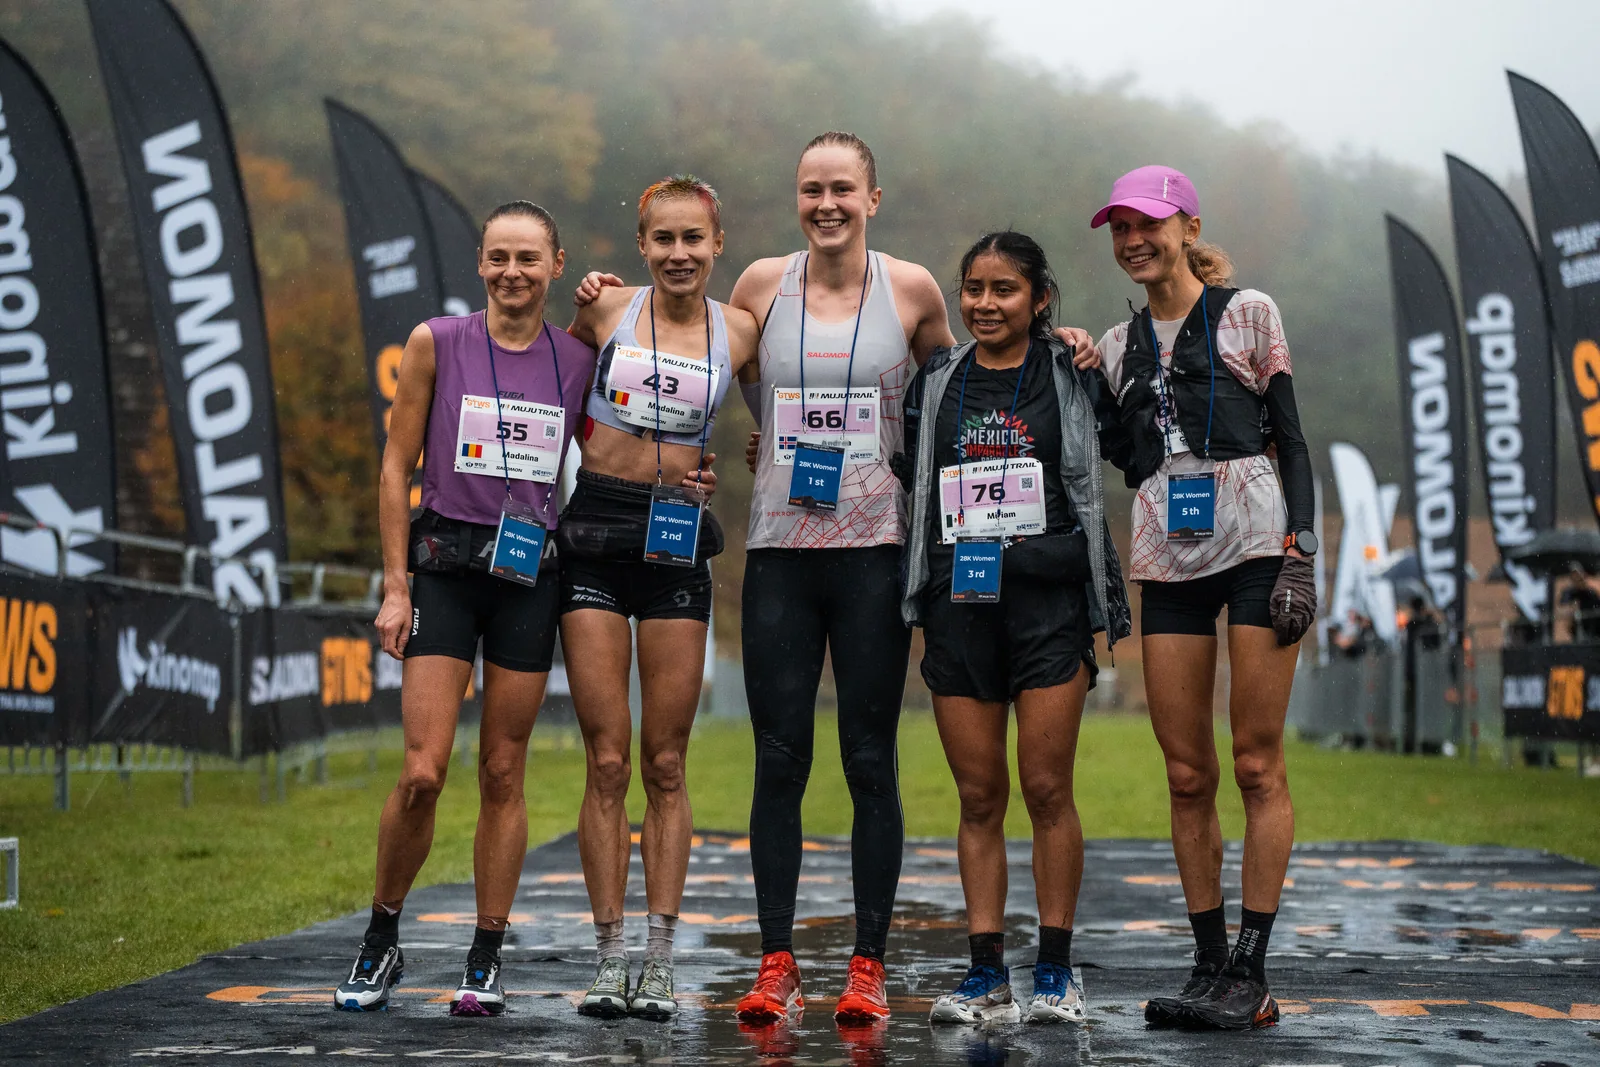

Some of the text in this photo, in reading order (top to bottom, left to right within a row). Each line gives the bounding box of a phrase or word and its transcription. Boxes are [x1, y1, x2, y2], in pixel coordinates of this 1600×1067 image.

[619, 349, 642, 359] GTWS
[661, 357, 689, 369] MUJU
[806, 351, 851, 359] SALOMON
[642, 373, 680, 395] 43
[778, 391, 875, 400] GTWS MUJU TRAIL
[466, 398, 561, 418] GTWS MUJU TRAIL
[807, 410, 843, 429] 66
[496, 420, 528, 442] 55
[798, 460, 838, 473] 28K Women
[983, 464, 1011, 473] MUJU
[1011, 462, 1037, 470] TRAIL
[808, 476, 825, 487] 1 st
[971, 481, 1006, 503] 76
[1181, 506, 1200, 516] 5 th
[654, 515, 693, 526] 28K Women
[503, 530, 539, 546] 28K Women
[660, 530, 682, 541] 2 nd
[509, 547, 516, 556] 4
[516, 549, 526, 559] th
[967, 569, 985, 578] 3 rd
[411, 607, 420, 636] FUGA
